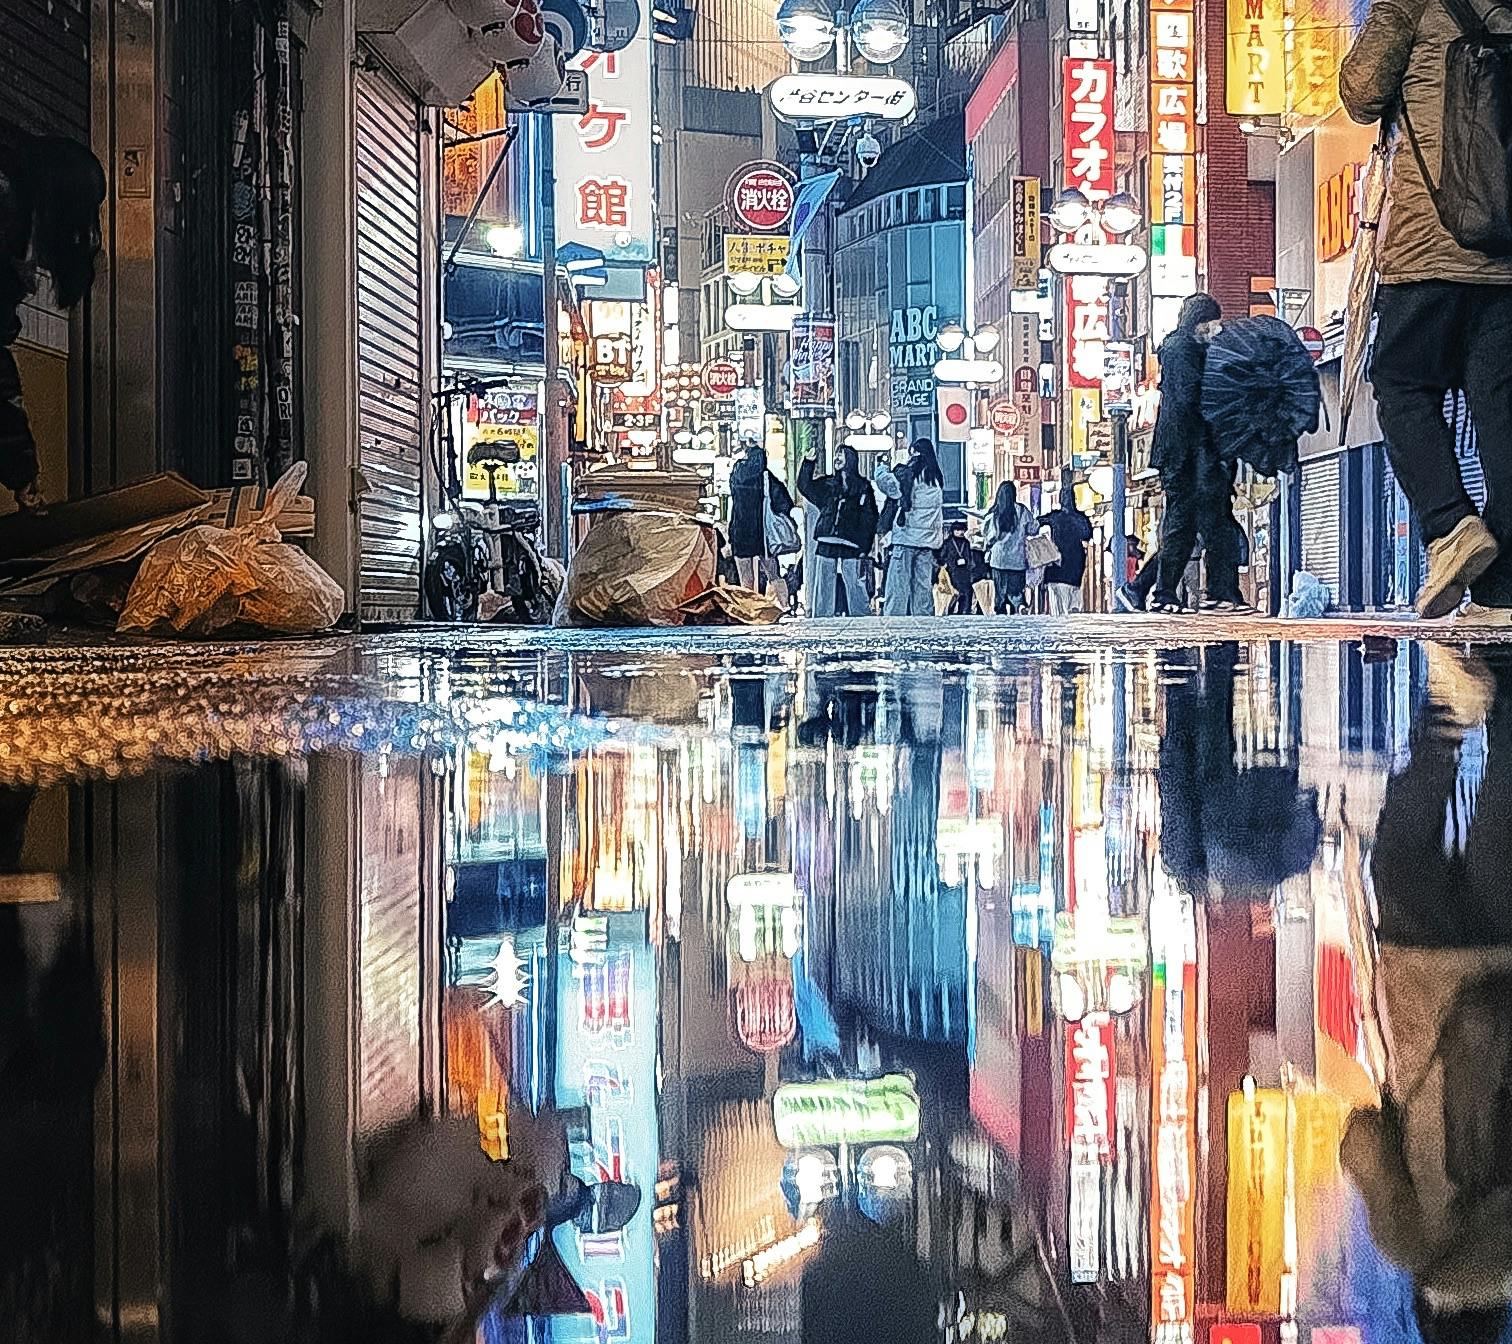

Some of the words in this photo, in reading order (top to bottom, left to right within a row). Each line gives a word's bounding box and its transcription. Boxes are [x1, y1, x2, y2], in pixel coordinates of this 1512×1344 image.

[741, 188, 789, 212] 消火栓
[889, 306, 938, 343] ABC
[889, 343, 938, 368] MART
[890, 378, 934, 394] GRAND
[891, 393, 929, 407] STAGE
